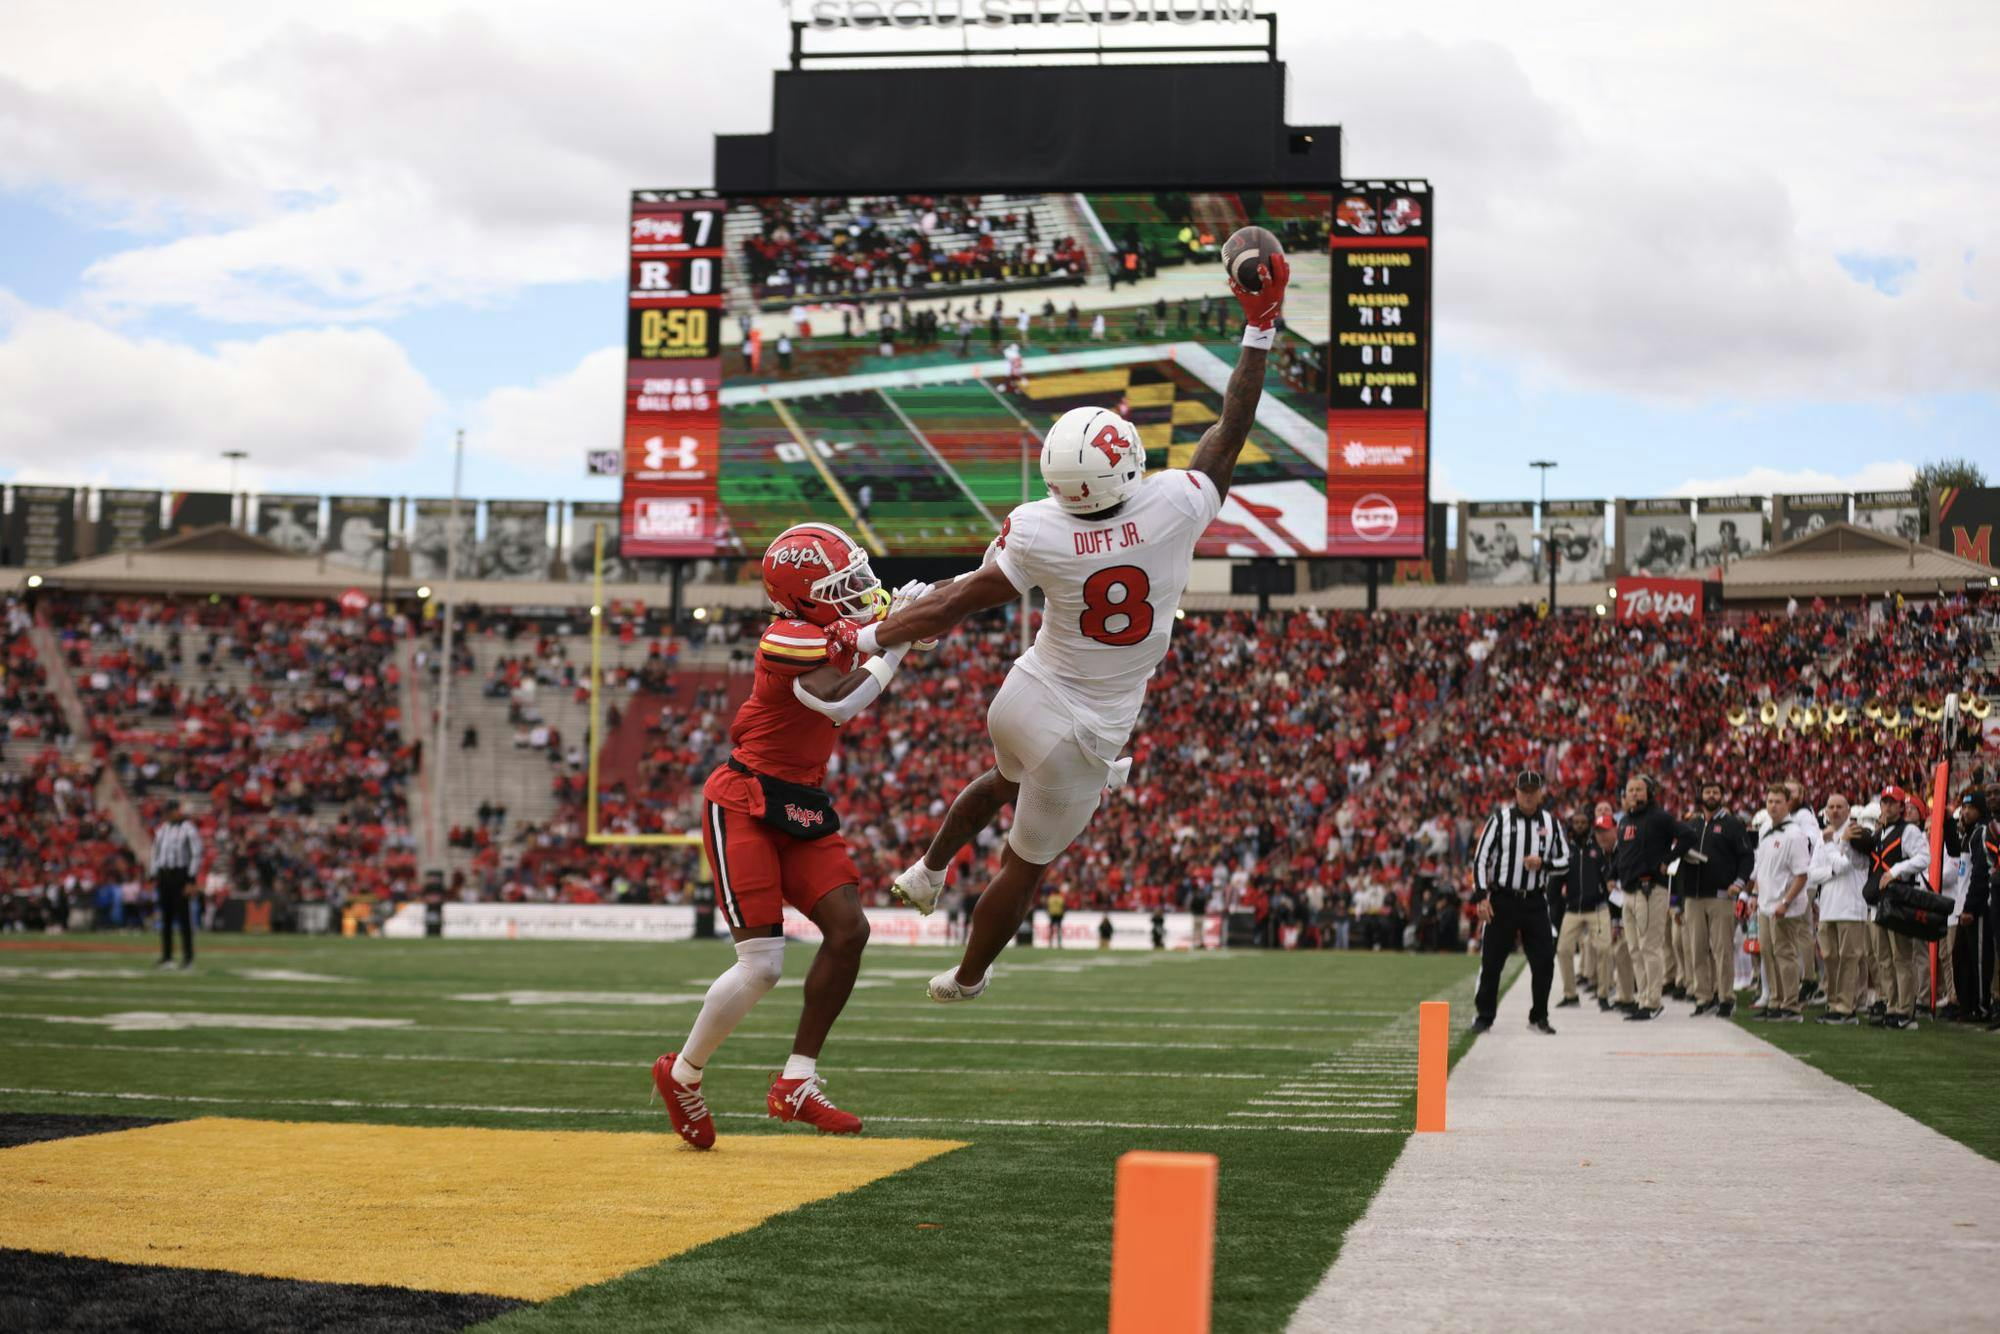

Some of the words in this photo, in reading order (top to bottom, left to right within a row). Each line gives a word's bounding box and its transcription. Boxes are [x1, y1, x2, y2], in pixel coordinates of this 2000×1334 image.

[692, 211, 714, 247] 7
[1347, 253, 1411, 267] RUSHING
[639, 261, 671, 290] R
[690, 258, 712, 294] 0
[1363, 267, 1374, 286] 2
[1382, 267, 1390, 285] 1
[1347, 294, 1409, 307] PASSING
[640, 309, 708, 347] 0:50
[1358, 308, 1374, 326] 71
[1381, 307, 1402, 326] 54
[1339, 332, 1417, 346] PENALTIES
[1361, 345, 1373, 365] 0
[1381, 345, 1393, 365] 0
[1338, 373, 1362, 386] 1ST
[1365, 373, 1418, 386] DOWNS
[1360, 386, 1372, 406] 4
[1380, 386, 1393, 406] 4
[1090, 425, 1131, 468] R
[1073, 528, 1114, 556] DUFF
[1119, 521, 1145, 548] JR.
[1952, 526, 1993, 569] M
[770, 541, 826, 570] Terps
[1080, 564, 1154, 647] 8
[1622, 586, 1697, 624] Terps
[784, 803, 824, 828] Terps
